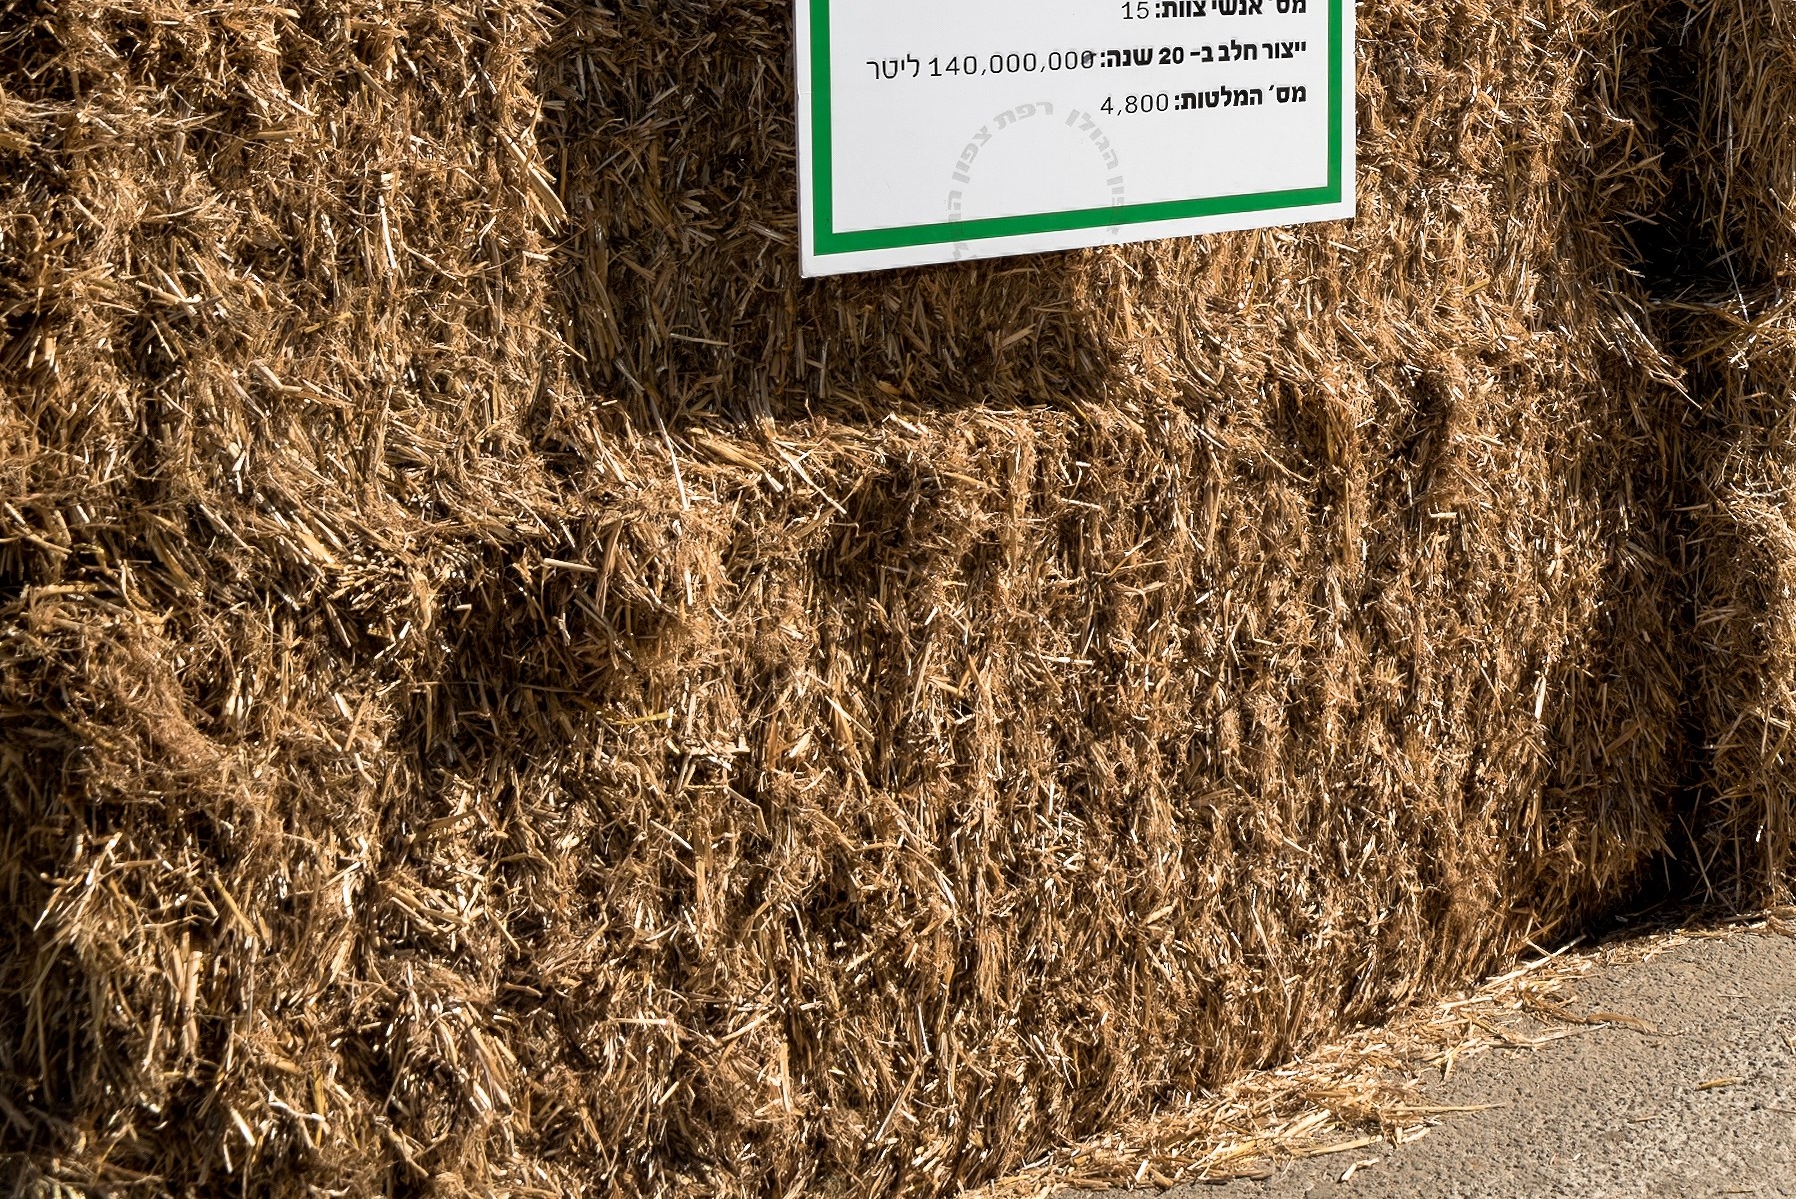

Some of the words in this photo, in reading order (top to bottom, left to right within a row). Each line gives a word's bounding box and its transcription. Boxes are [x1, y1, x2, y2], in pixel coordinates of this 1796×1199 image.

[1121, 1, 1150, 20] 15
[1155, 0, 1207, 19] צוות:
[1100, 47, 1154, 68] שנה:
[1158, 46, 1185, 65] 20
[1218, 39, 1258, 62] חלב
[1261, 40, 1307, 60] ייצור
[866, 53, 920, 80] ליטר
[928, 50, 1097, 77] 140,000,000
[1100, 93, 1169, 115] 4,800
[1174, 85, 1263, 111] המלטות:
